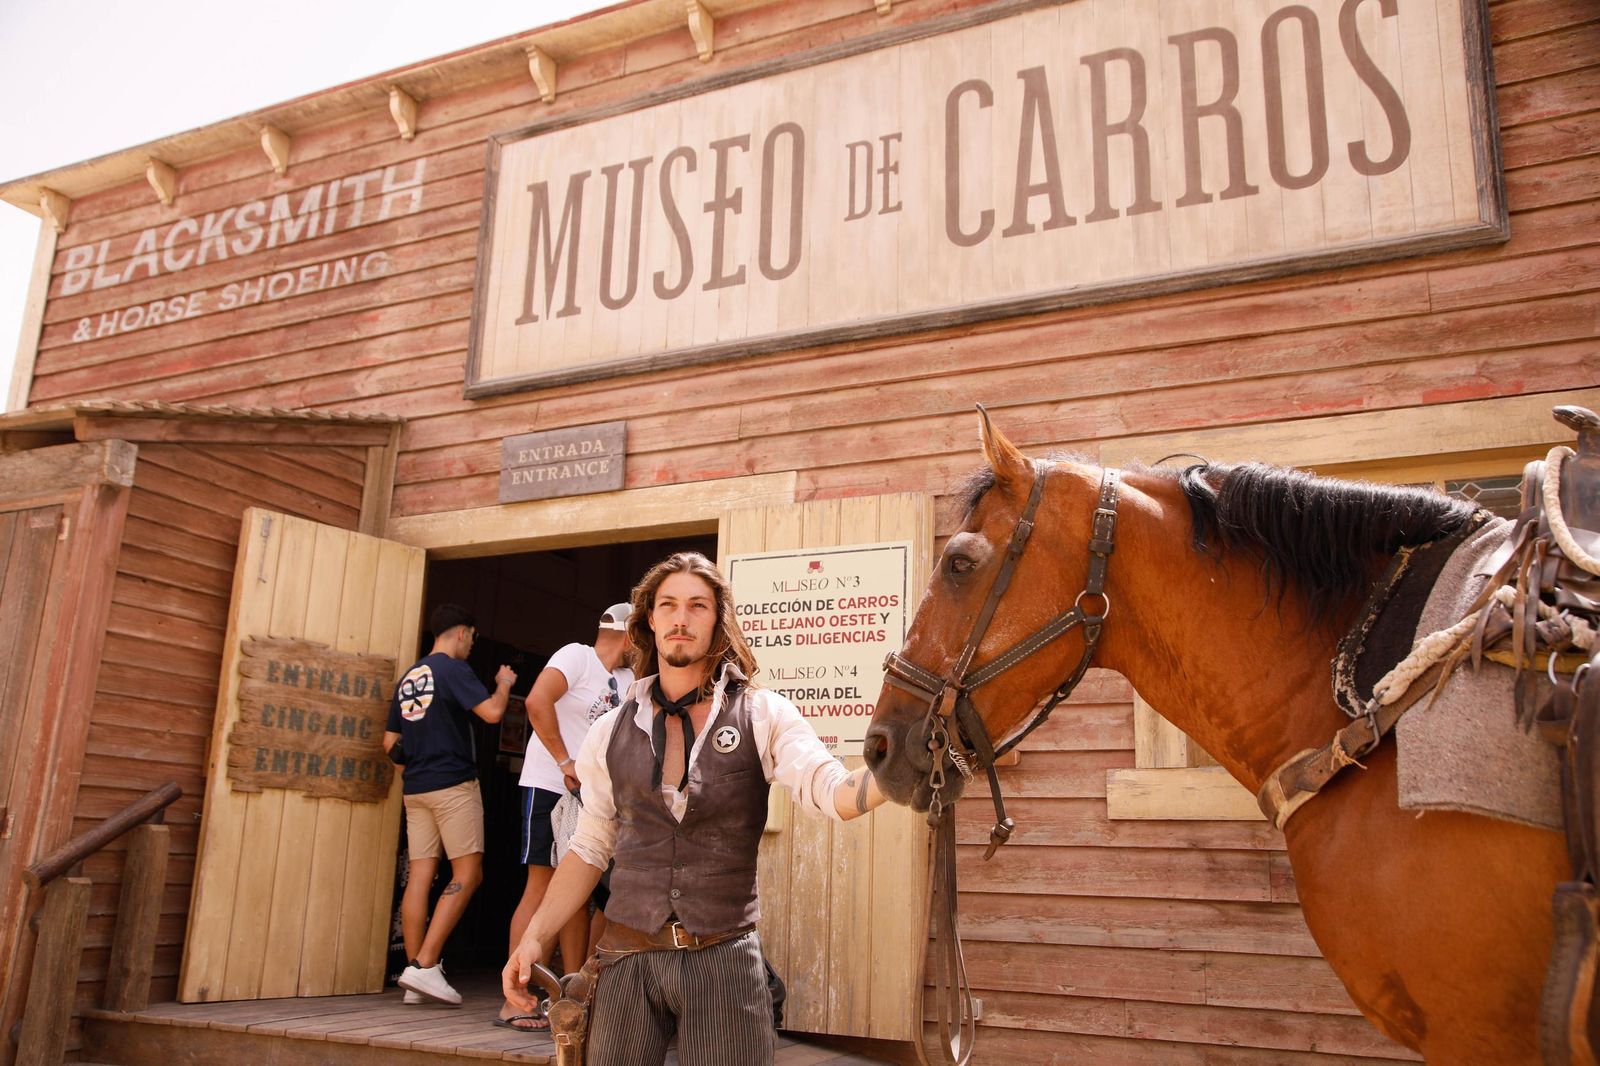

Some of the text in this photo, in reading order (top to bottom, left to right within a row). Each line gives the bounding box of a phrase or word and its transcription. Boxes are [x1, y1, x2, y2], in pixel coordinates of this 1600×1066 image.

[514, 0, 1412, 326] MUSEO DE CARROS
[59, 157, 428, 297] BLACKSMITH
[219, 251, 390, 311] SHOEING
[518, 439, 606, 464] ENTRADA
[511, 459, 610, 486] ENTRANCE
[736, 594, 899, 617] COLECCIÓN DE CARROS
[742, 612, 890, 632] DEL LEJANO OESTE Y
[766, 634, 792, 647] LAS
[795, 629, 886, 646] DILIGENCIAS
[266, 659, 383, 699] ENTRADA
[771, 687, 862, 701] STORIA DEL
[254, 746, 390, 785] ENTRANCE
